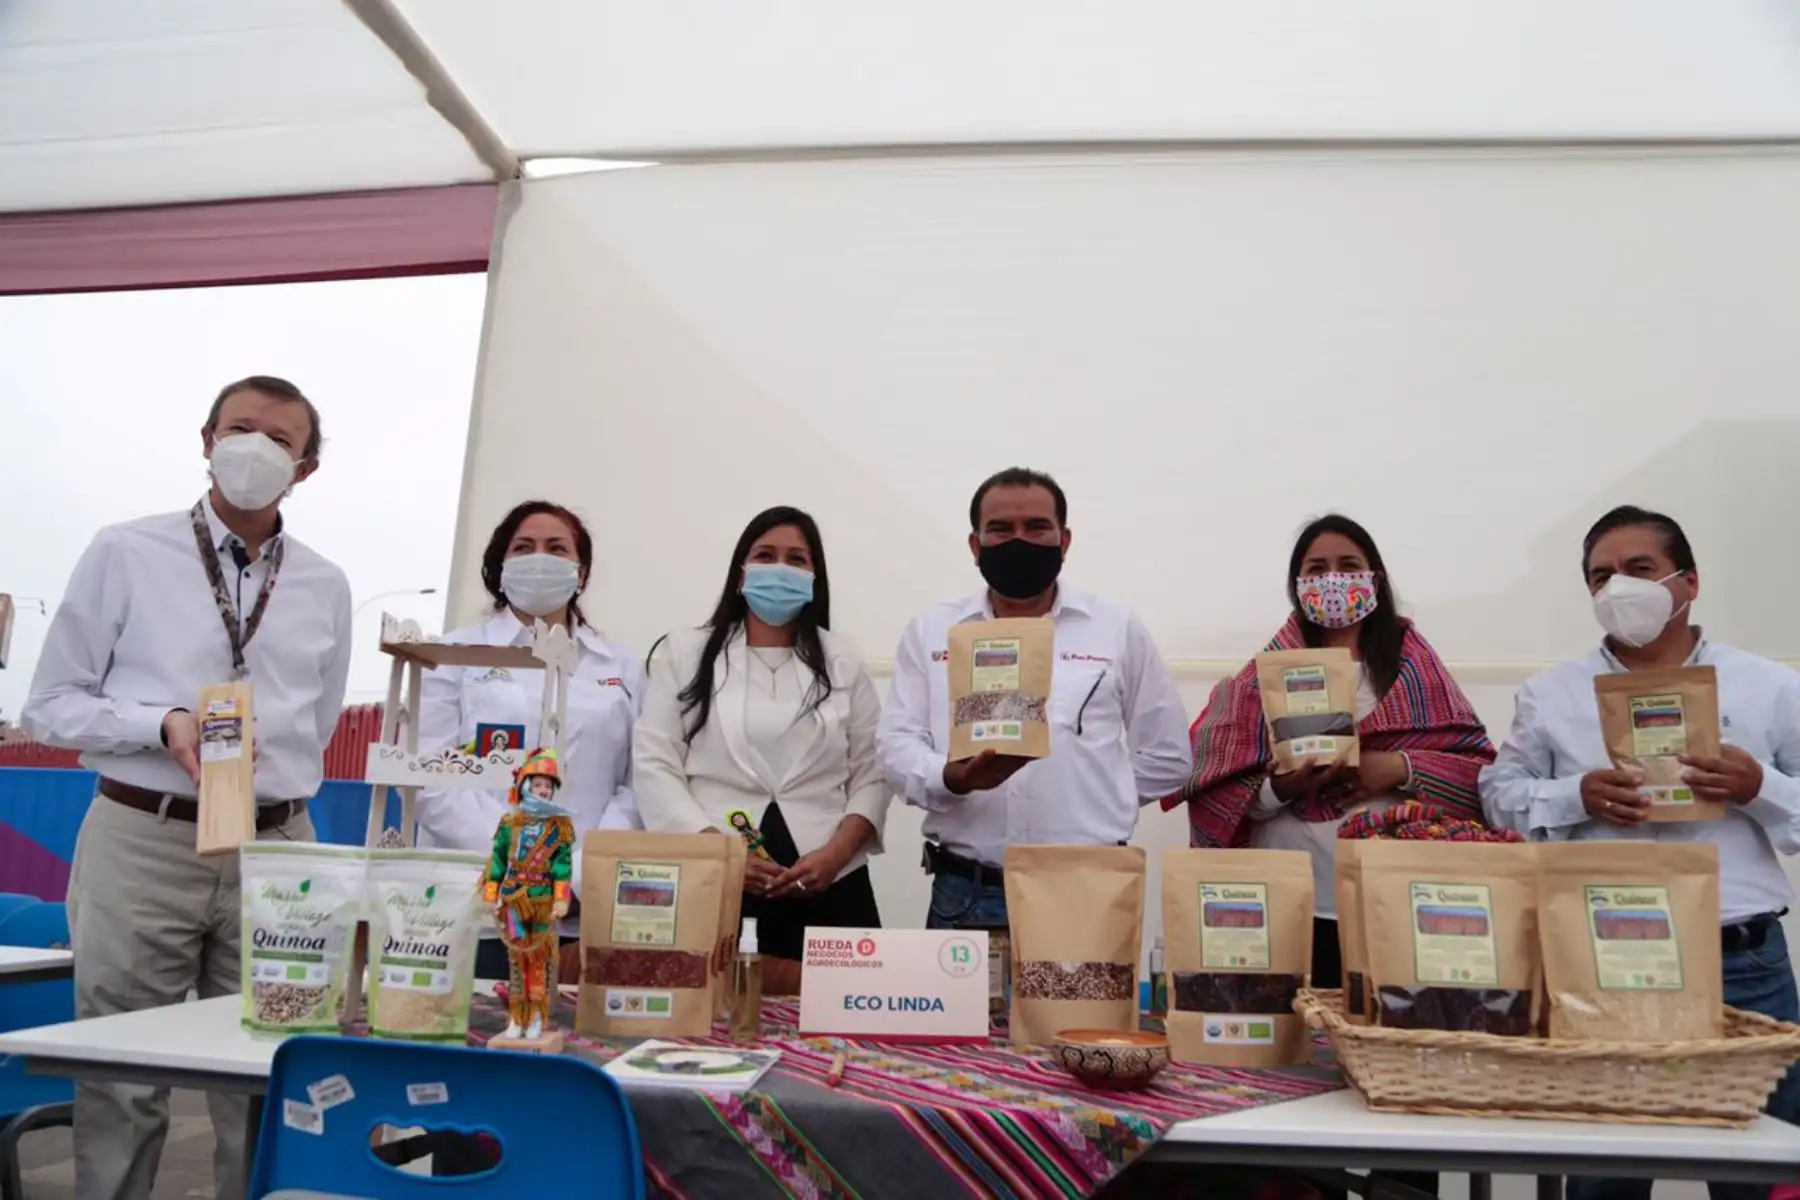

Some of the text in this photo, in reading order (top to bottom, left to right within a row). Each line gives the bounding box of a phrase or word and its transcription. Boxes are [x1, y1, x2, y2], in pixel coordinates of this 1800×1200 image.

[253, 927, 326, 950] Quinoa
[382, 934, 450, 957] Quinoa
[808, 939, 853, 950] RUEDA
[806, 950, 854, 959] NEGOCIOS
[951, 946, 970, 963] 13
[843, 995, 945, 1012] ECO LINDA
